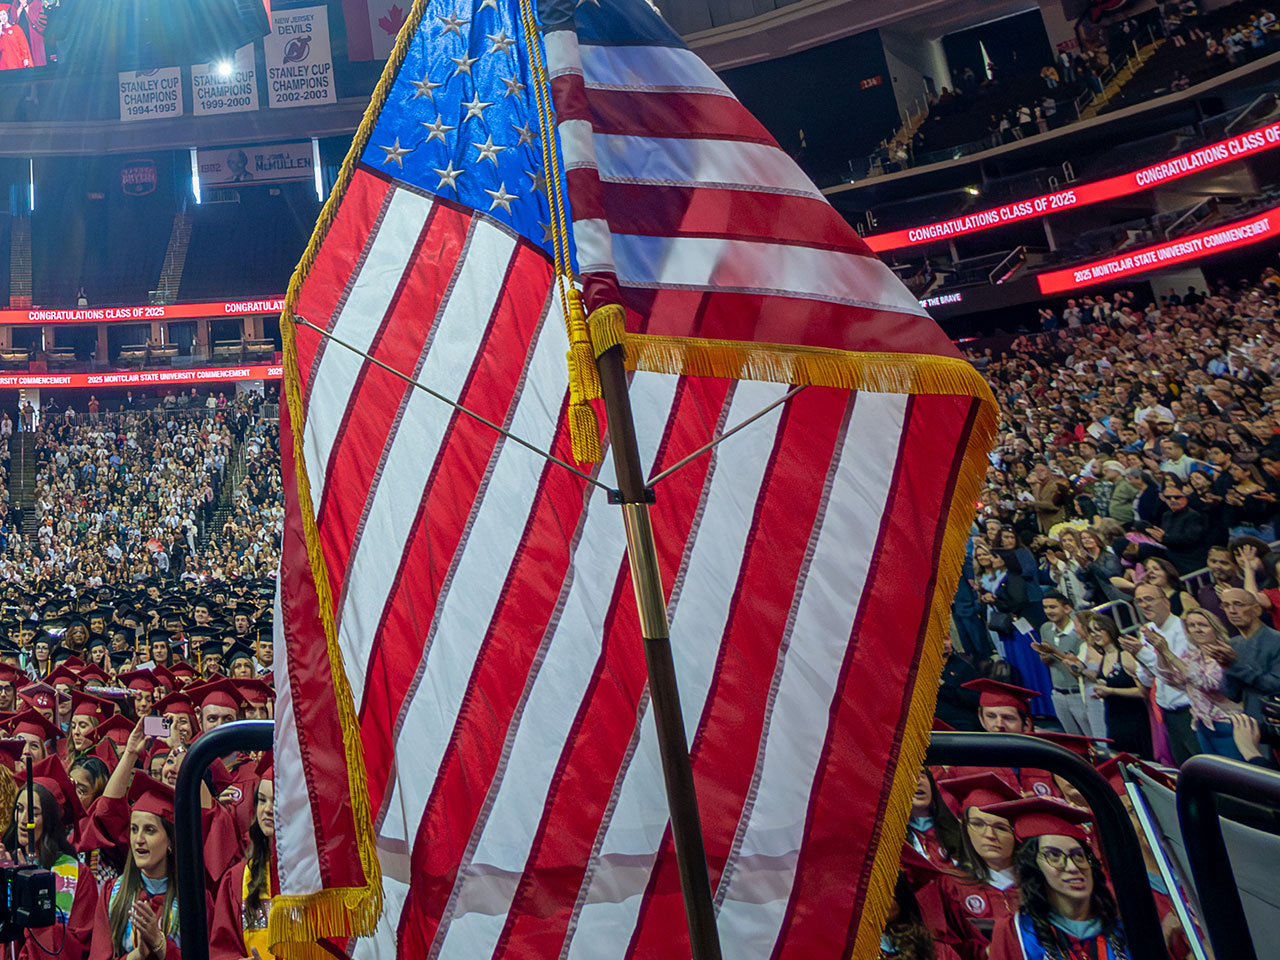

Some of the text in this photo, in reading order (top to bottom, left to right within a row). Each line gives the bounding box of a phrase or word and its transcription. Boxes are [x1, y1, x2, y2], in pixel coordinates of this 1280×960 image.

[274, 14, 314, 24] NEW JERSEY
[278, 23, 312, 35] DEVILS
[235, 71, 254, 83] CUP
[269, 63, 330, 79] STANLEY CUP
[120, 77, 179, 94] STANLEY CUP
[272, 76, 328, 92] CHAMPIONS
[124, 90, 178, 106] CHAMPIONS
[198, 84, 252, 99] CHAMPIONS
[276, 90, 328, 102] 2002-2003
[127, 103, 176, 116] 1994-1995
[200, 97, 250, 110] 1999-2000
[1136, 126, 1280, 186] CONGRATULATIONS CLASS OF
[908, 191, 1076, 242] CONGRATULATIONS CLASS OF 2025
[1074, 219, 1270, 282] 2025 MONTCLAIR STATE UNIVERSITY COMMENCEMENT
[928, 293, 962, 306] THE BRAVE
[28, 308, 164, 320] CONGRATULATIONS CLASS OF 2025
[140, 373, 158, 381] STATE
[160, 371, 196, 380] UNIVERSITY
[196, 370, 250, 379] COMMENCEMENT
[268, 367, 283, 375] 2025
